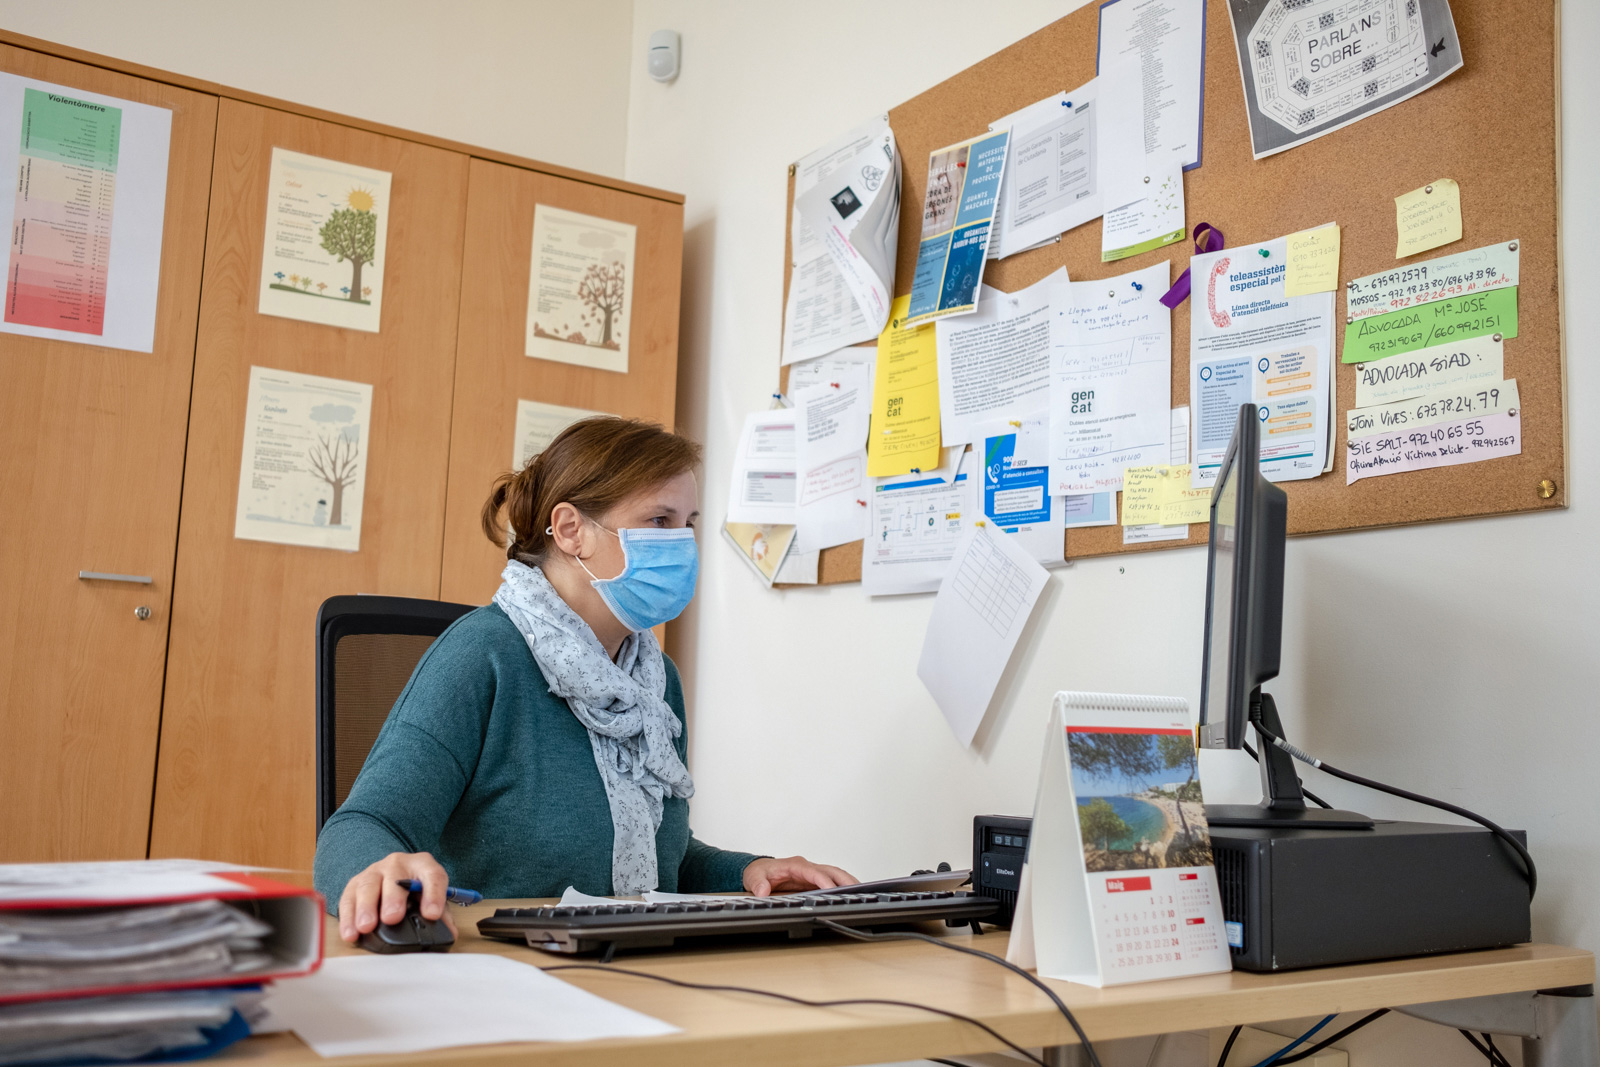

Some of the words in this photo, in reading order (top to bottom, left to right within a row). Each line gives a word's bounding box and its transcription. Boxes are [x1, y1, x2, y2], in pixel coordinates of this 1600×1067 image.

[1308, 10, 1382, 54] PARLA'NS
[1310, 40, 1362, 73] SOBRE
[48, 94, 106, 113] Violentòmetre
[1230, 276, 1269, 293] especial
[1270, 276, 1281, 286] pel
[1350, 294, 1380, 307] MOSSOS
[1388, 288, 1404, 300] 972
[1419, 283, 1430, 292] 23
[1486, 266, 1497, 278] 96
[1351, 283, 1362, 294] PL
[1250, 299, 1271, 309] directa
[1390, 297, 1411, 309] 972
[1455, 293, 1489, 314] JOSÉ
[1232, 306, 1260, 318] d'atenció
[888, 397, 904, 409] gen
[1071, 390, 1095, 405] gen
[887, 407, 901, 418] cat
[1071, 402, 1092, 414] cat
[1430, 428, 1445, 441] 40
[1447, 425, 1463, 440] 65
[1466, 420, 1485, 437] 55
[1003, 471, 1022, 479] d'atenció
[996, 868, 1015, 876] EliteDesk
[1107, 880, 1125, 891] Maig
[1150, 896, 1154, 905] 1
[1168, 895, 1173, 904] 3
[1115, 914, 1119, 922] 4
[1124, 913, 1129, 922] 5
[1133, 913, 1138, 921] 6
[1143, 911, 1147, 920] 7
[1152, 911, 1157, 919] 8
[1161, 910, 1165, 919] 9
[1168, 909, 1175, 918] 10
[1115, 929, 1122, 938] 11
[1124, 927, 1131, 937] 12
[1133, 927, 1141, 936] 13
[1143, 926, 1150, 935] 14
[1152, 925, 1159, 934] 15
[1161, 924, 1168, 933] 16
[1170, 924, 1177, 932] 17
[1117, 943, 1124, 953] 18
[1126, 942, 1133, 952] 19
[1135, 941, 1143, 951] 20
[1145, 940, 1152, 950] 21
[1154, 939, 1161, 949] 22
[1162, 939, 1170, 948] 23
[1171, 938, 1179, 947] 24
[1118, 957, 1126, 968] 25
[1127, 957, 1135, 967] 26
[1137, 956, 1144, 966] 27
[1146, 955, 1154, 964] 28
[1155, 954, 1163, 963] 29
[1164, 953, 1172, 962] 30
[1174, 952, 1182, 961] 31
